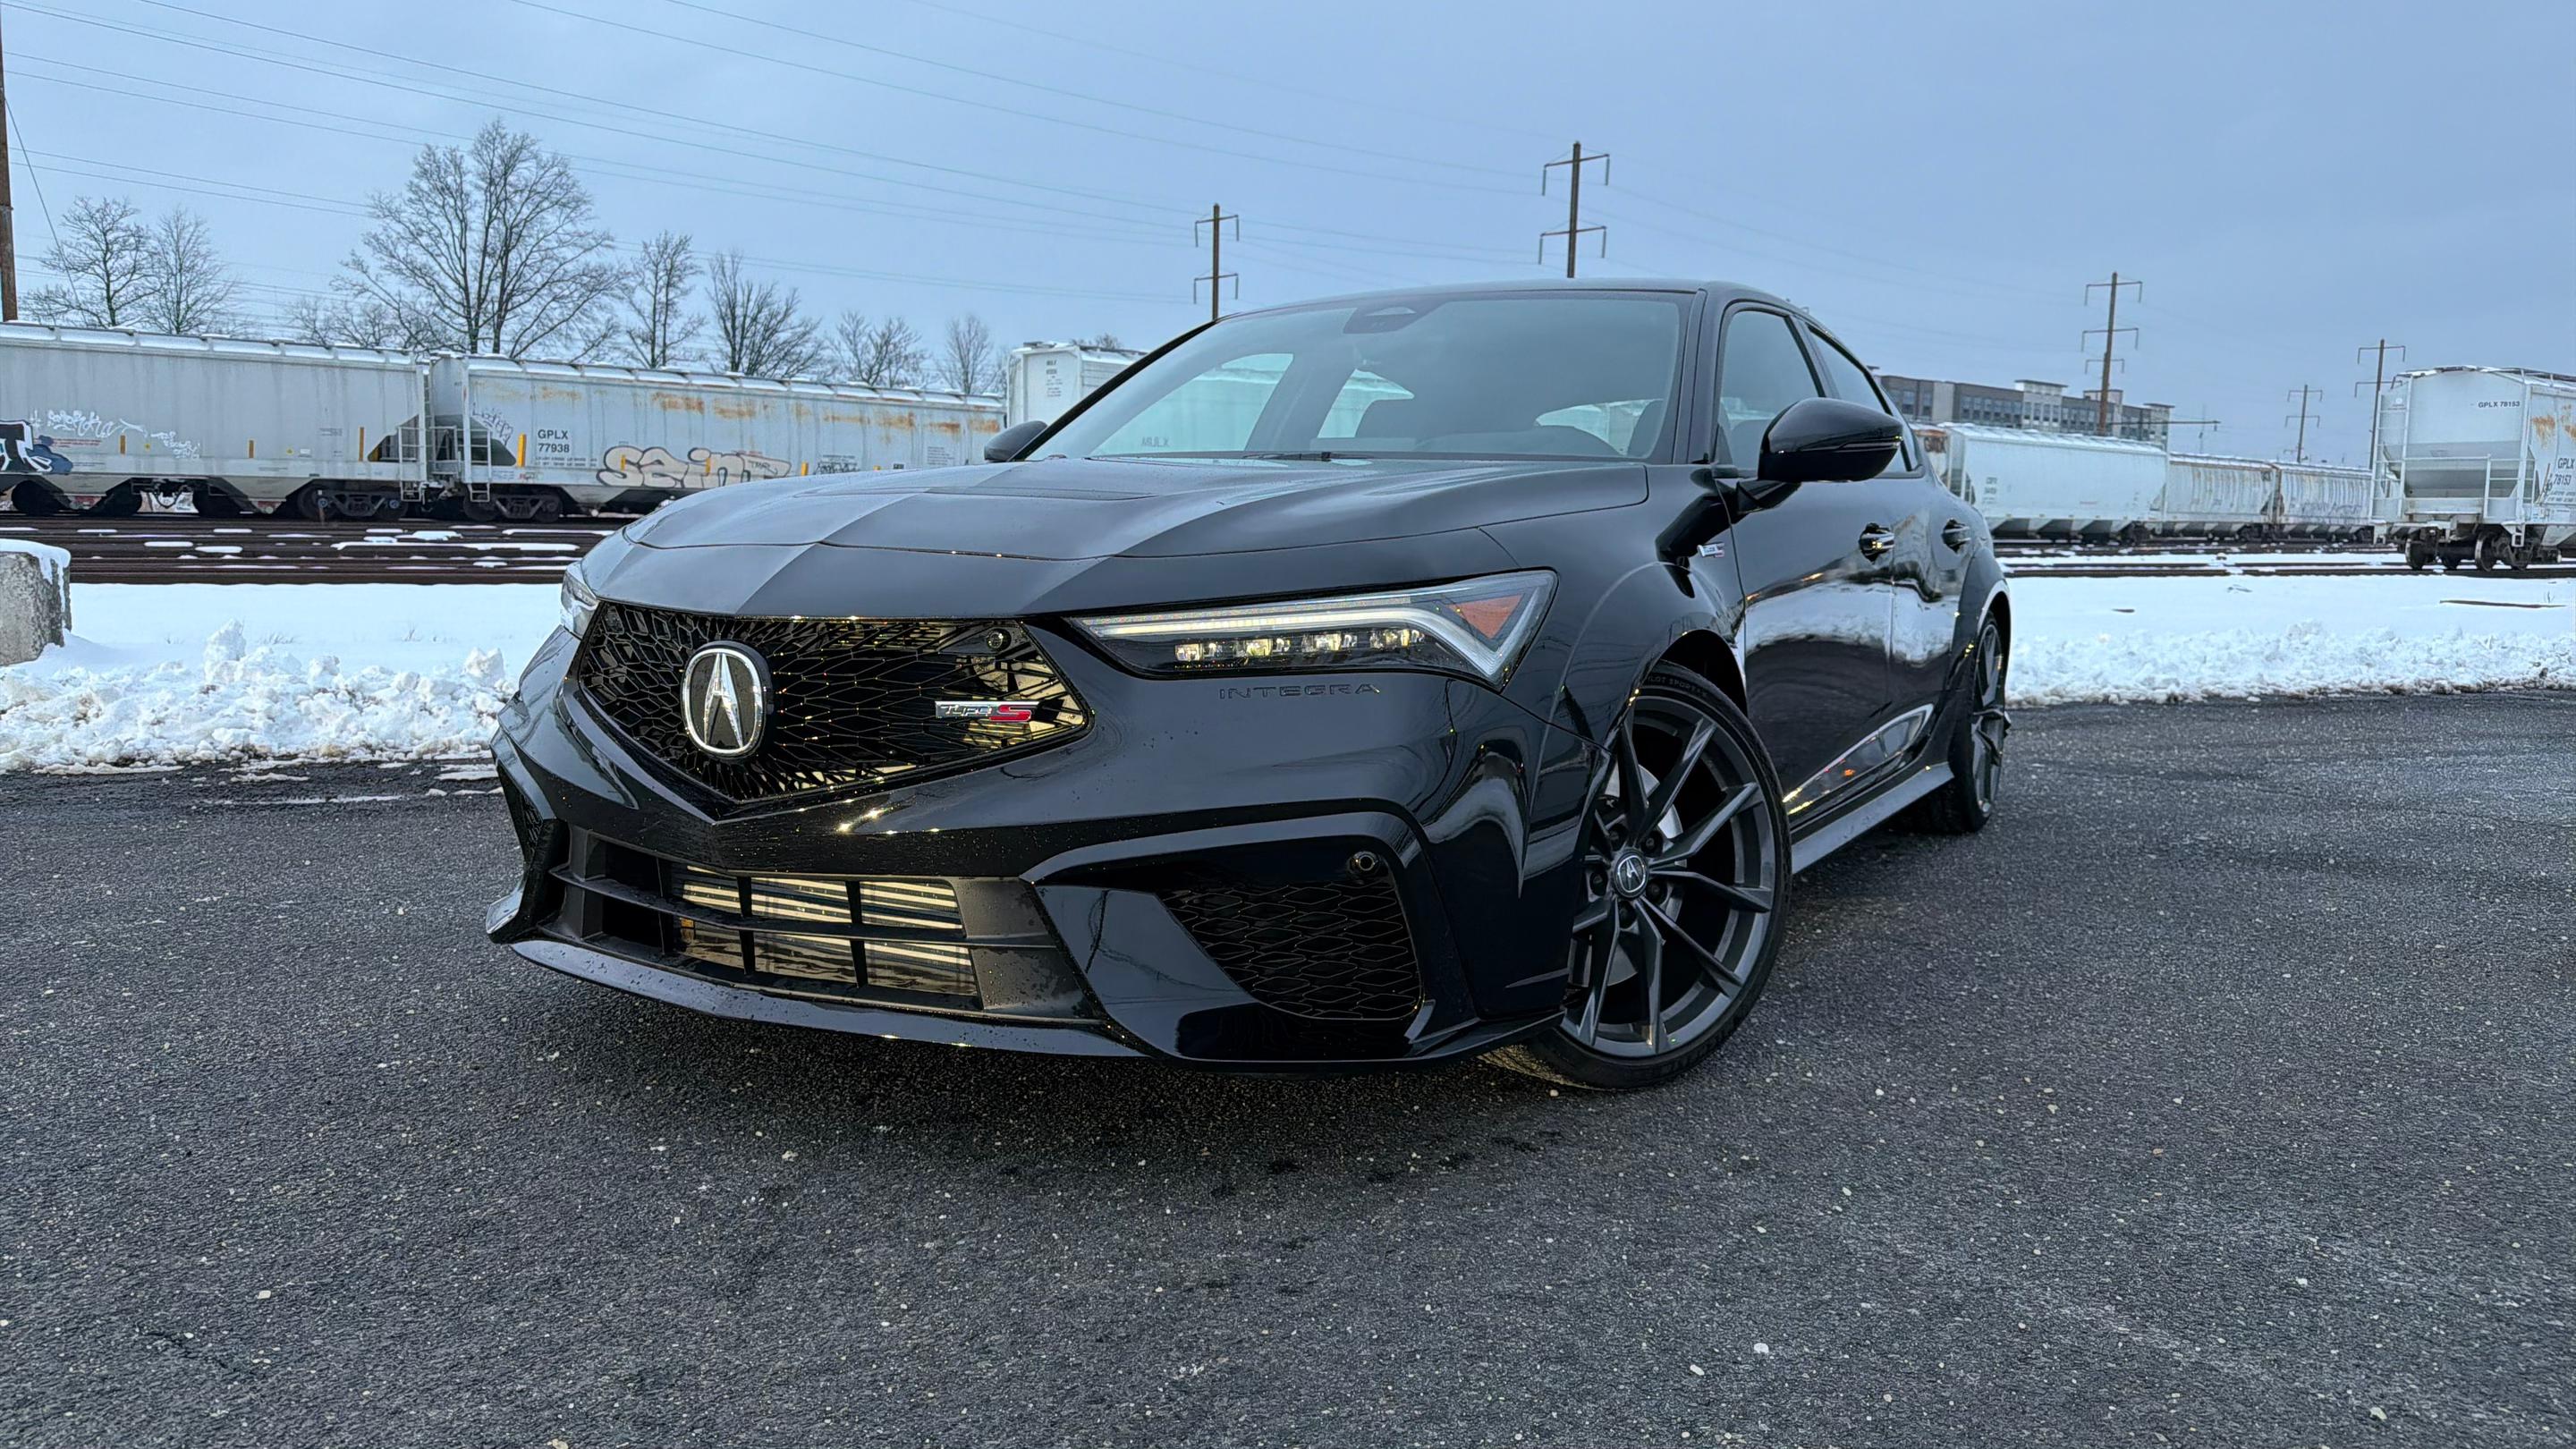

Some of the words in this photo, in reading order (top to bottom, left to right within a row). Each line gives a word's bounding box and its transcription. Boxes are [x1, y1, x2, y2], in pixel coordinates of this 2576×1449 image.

[2478, 401, 2498, 409] GPLX
[538, 428, 568, 440] GPLX
[538, 443, 570, 453] 77938
[2557, 457, 2575, 470] GPLX
[2554, 473, 2572, 486] 78153
[1219, 683, 1381, 699] INTEGRA
[988, 704, 1032, 723] S
